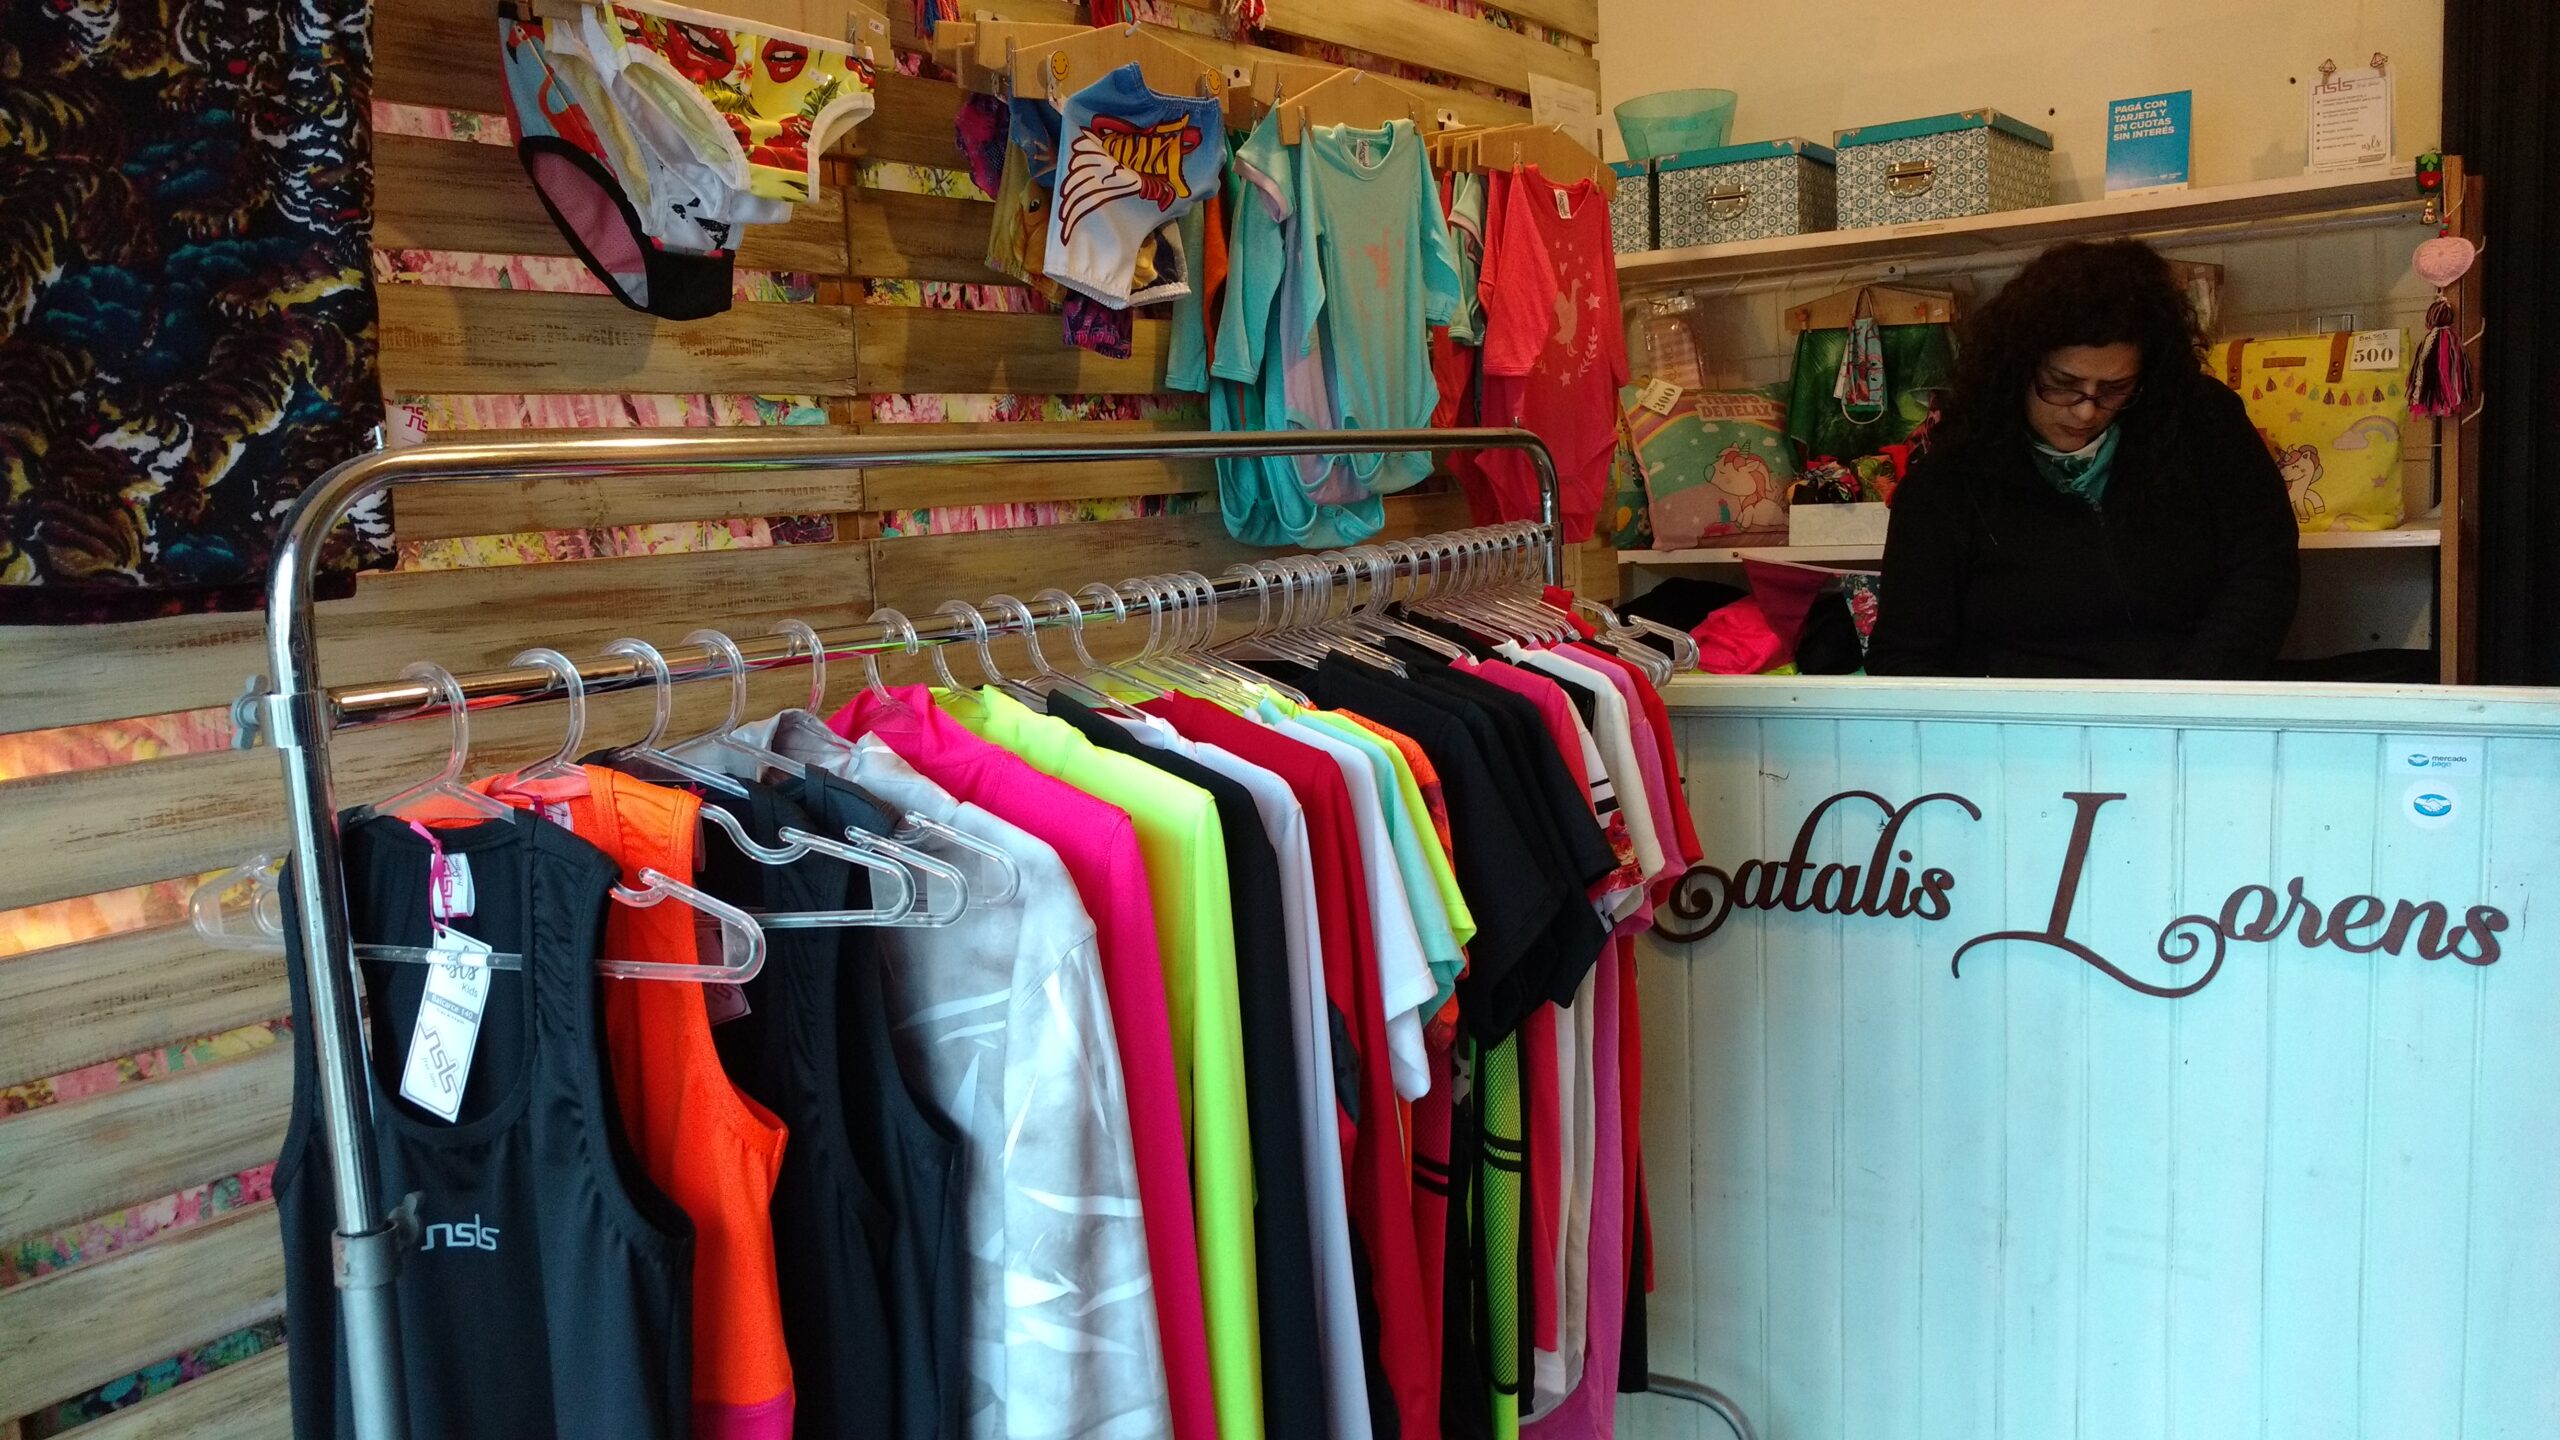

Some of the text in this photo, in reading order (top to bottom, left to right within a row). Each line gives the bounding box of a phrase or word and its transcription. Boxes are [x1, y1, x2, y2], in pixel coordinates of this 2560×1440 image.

[2312, 78, 2355, 96] nsls
[2114, 100, 2168, 113] PAGÁ CON
[2114, 117, 2171, 132] EN CUOTAS
[2115, 111, 2157, 123] TARJETA
[2113, 126, 2175, 141] SIN INTERÉS
[2353, 348, 2394, 363] 500
[1653, 387, 1676, 411] 300
[1702, 404, 1773, 418] DE RELAX
[1952, 792, 2509, 998] Lorens
[461, 982, 478, 999] Kids
[420, 1022, 459, 1094] nsls
[421, 1213, 500, 1251] nsls
